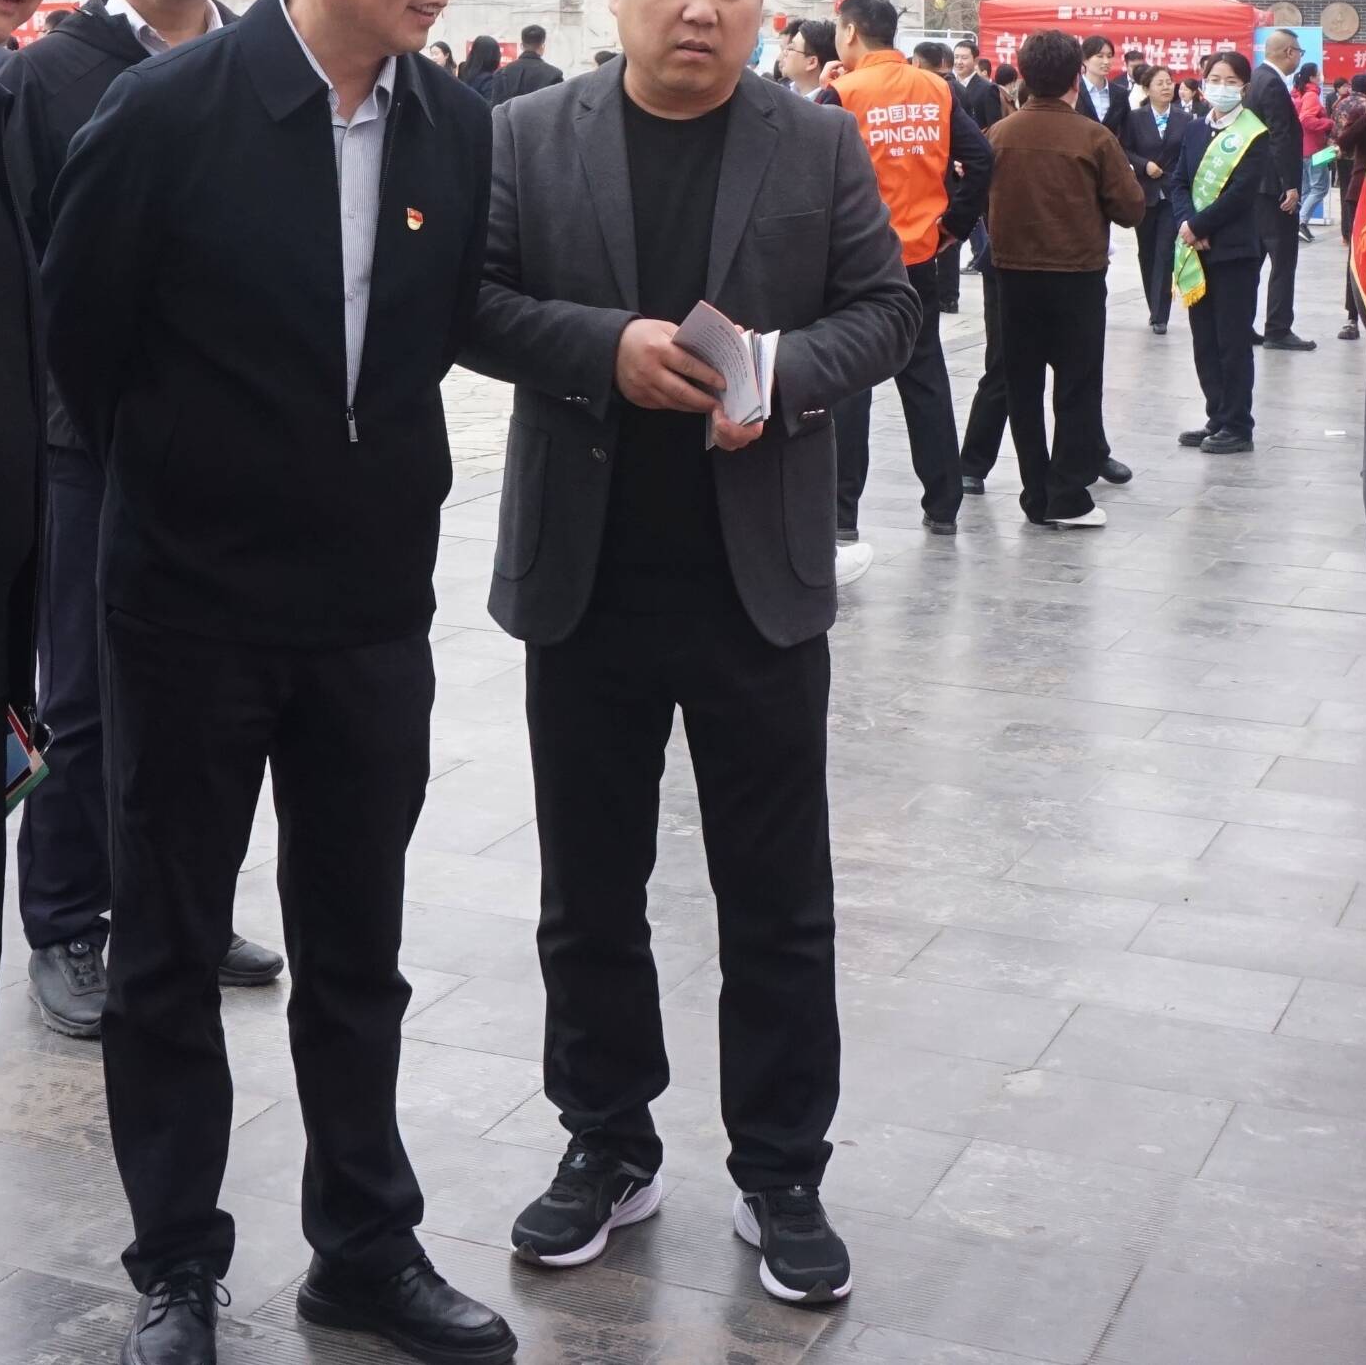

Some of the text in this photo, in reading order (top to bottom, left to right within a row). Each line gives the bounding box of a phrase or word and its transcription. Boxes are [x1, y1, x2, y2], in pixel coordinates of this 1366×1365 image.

[866, 103, 940, 126] 中国平安
[869, 125, 940, 147] PINGAN
